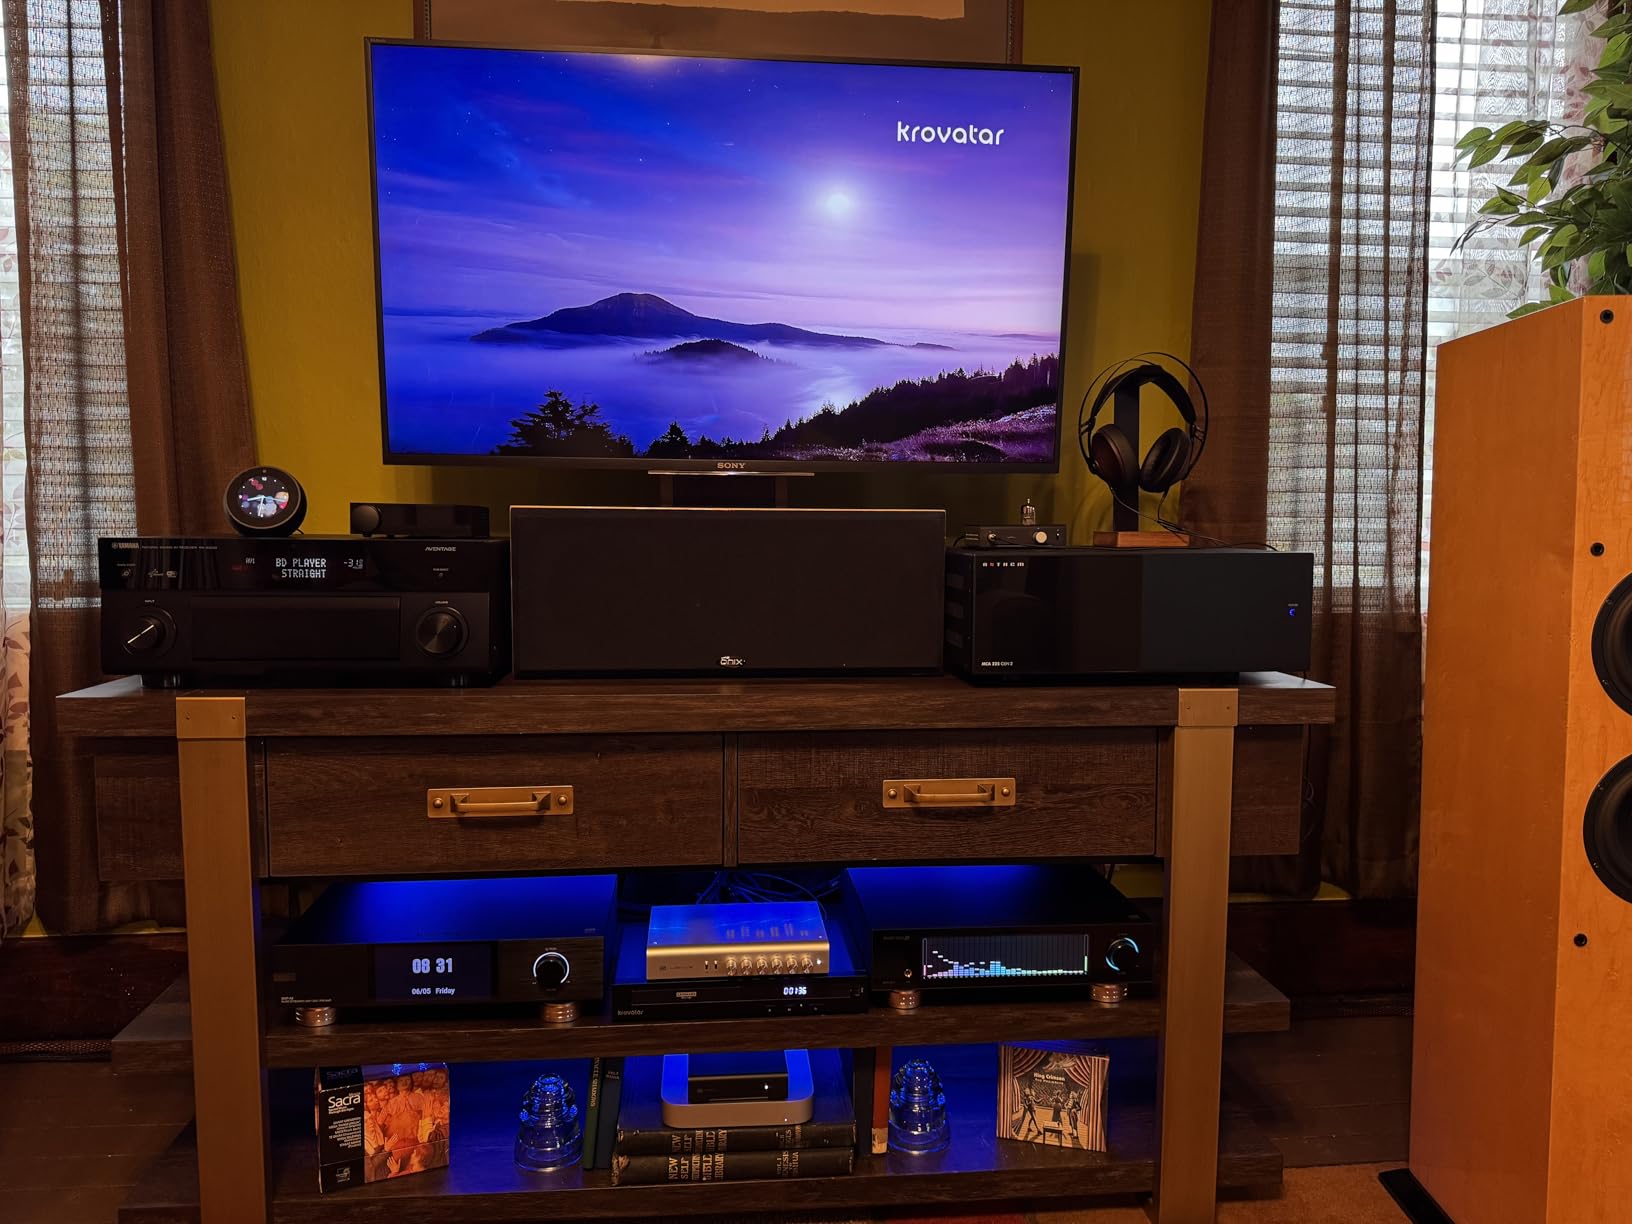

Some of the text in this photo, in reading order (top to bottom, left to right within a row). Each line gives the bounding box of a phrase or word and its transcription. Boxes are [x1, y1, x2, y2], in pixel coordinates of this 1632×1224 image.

[897, 120, 1005, 145] krovatar
[275, 557, 327, 568] BD PLAYER
[281, 568, 327, 579] STRAIGHT
[412, 957, 453, 974] 08 31
[411, 986, 456, 996] 06/05 Friday
[327, 1094, 361, 1109] Sacra
[668, 1156, 679, 1180] NEW
[680, 1156, 690, 1180] SELF
[702, 1153, 713, 1182] BIBLE
